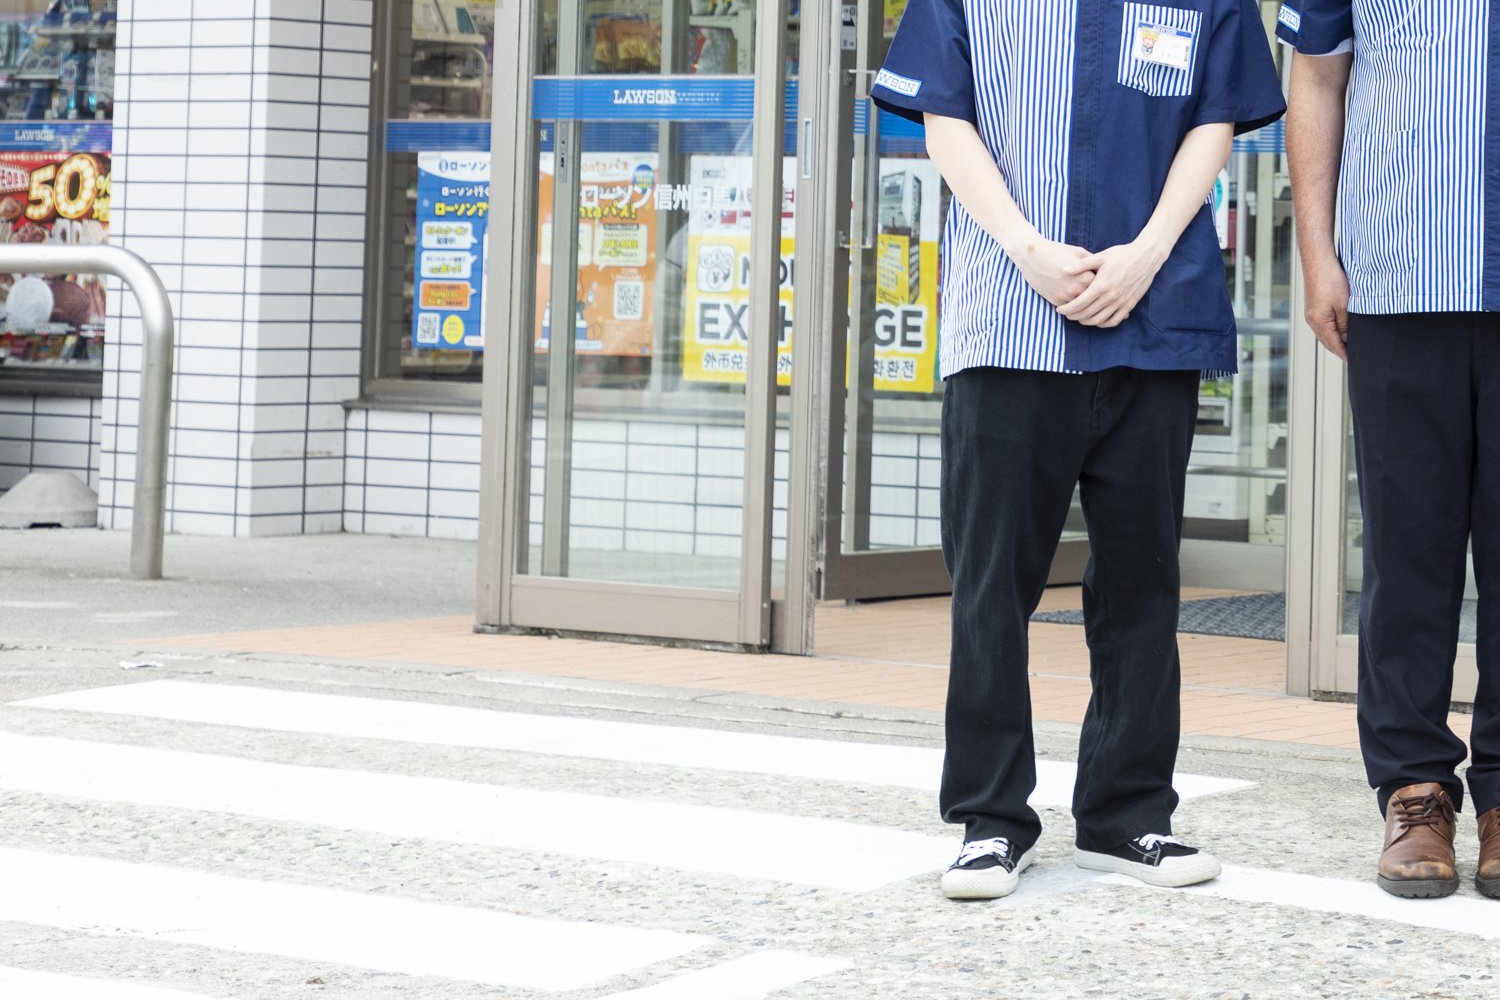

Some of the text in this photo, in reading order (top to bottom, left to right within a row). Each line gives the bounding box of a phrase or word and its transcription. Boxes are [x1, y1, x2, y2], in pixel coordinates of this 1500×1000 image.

[613, 89, 677, 105] LAWSON
[14, 129, 55, 141] LAWSON
[449, 160, 490, 172] ローソン
[581, 158, 629, 173] ontaパス
